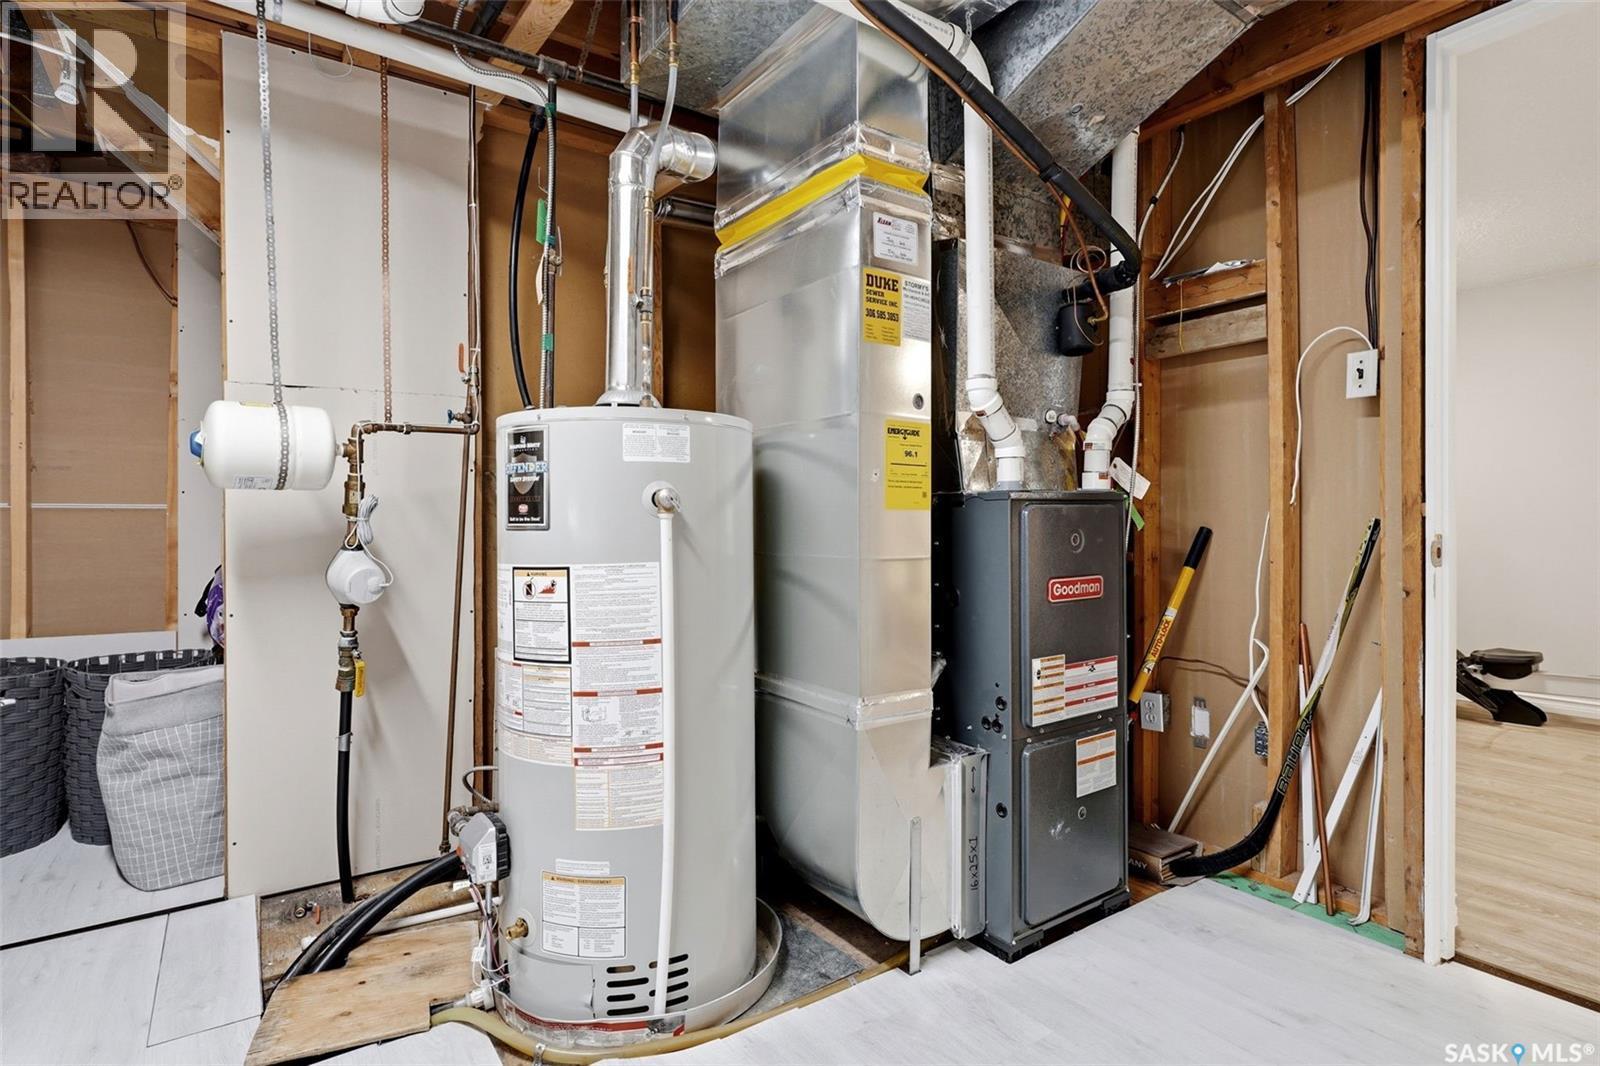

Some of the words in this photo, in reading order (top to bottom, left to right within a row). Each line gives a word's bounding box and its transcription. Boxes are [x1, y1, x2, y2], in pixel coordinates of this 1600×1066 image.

[866, 273, 899, 292] DUKE
[866, 288, 885, 297] SEWER
[866, 296, 888, 306] SERVICE
[1053, 581, 1100, 596] Goodman
